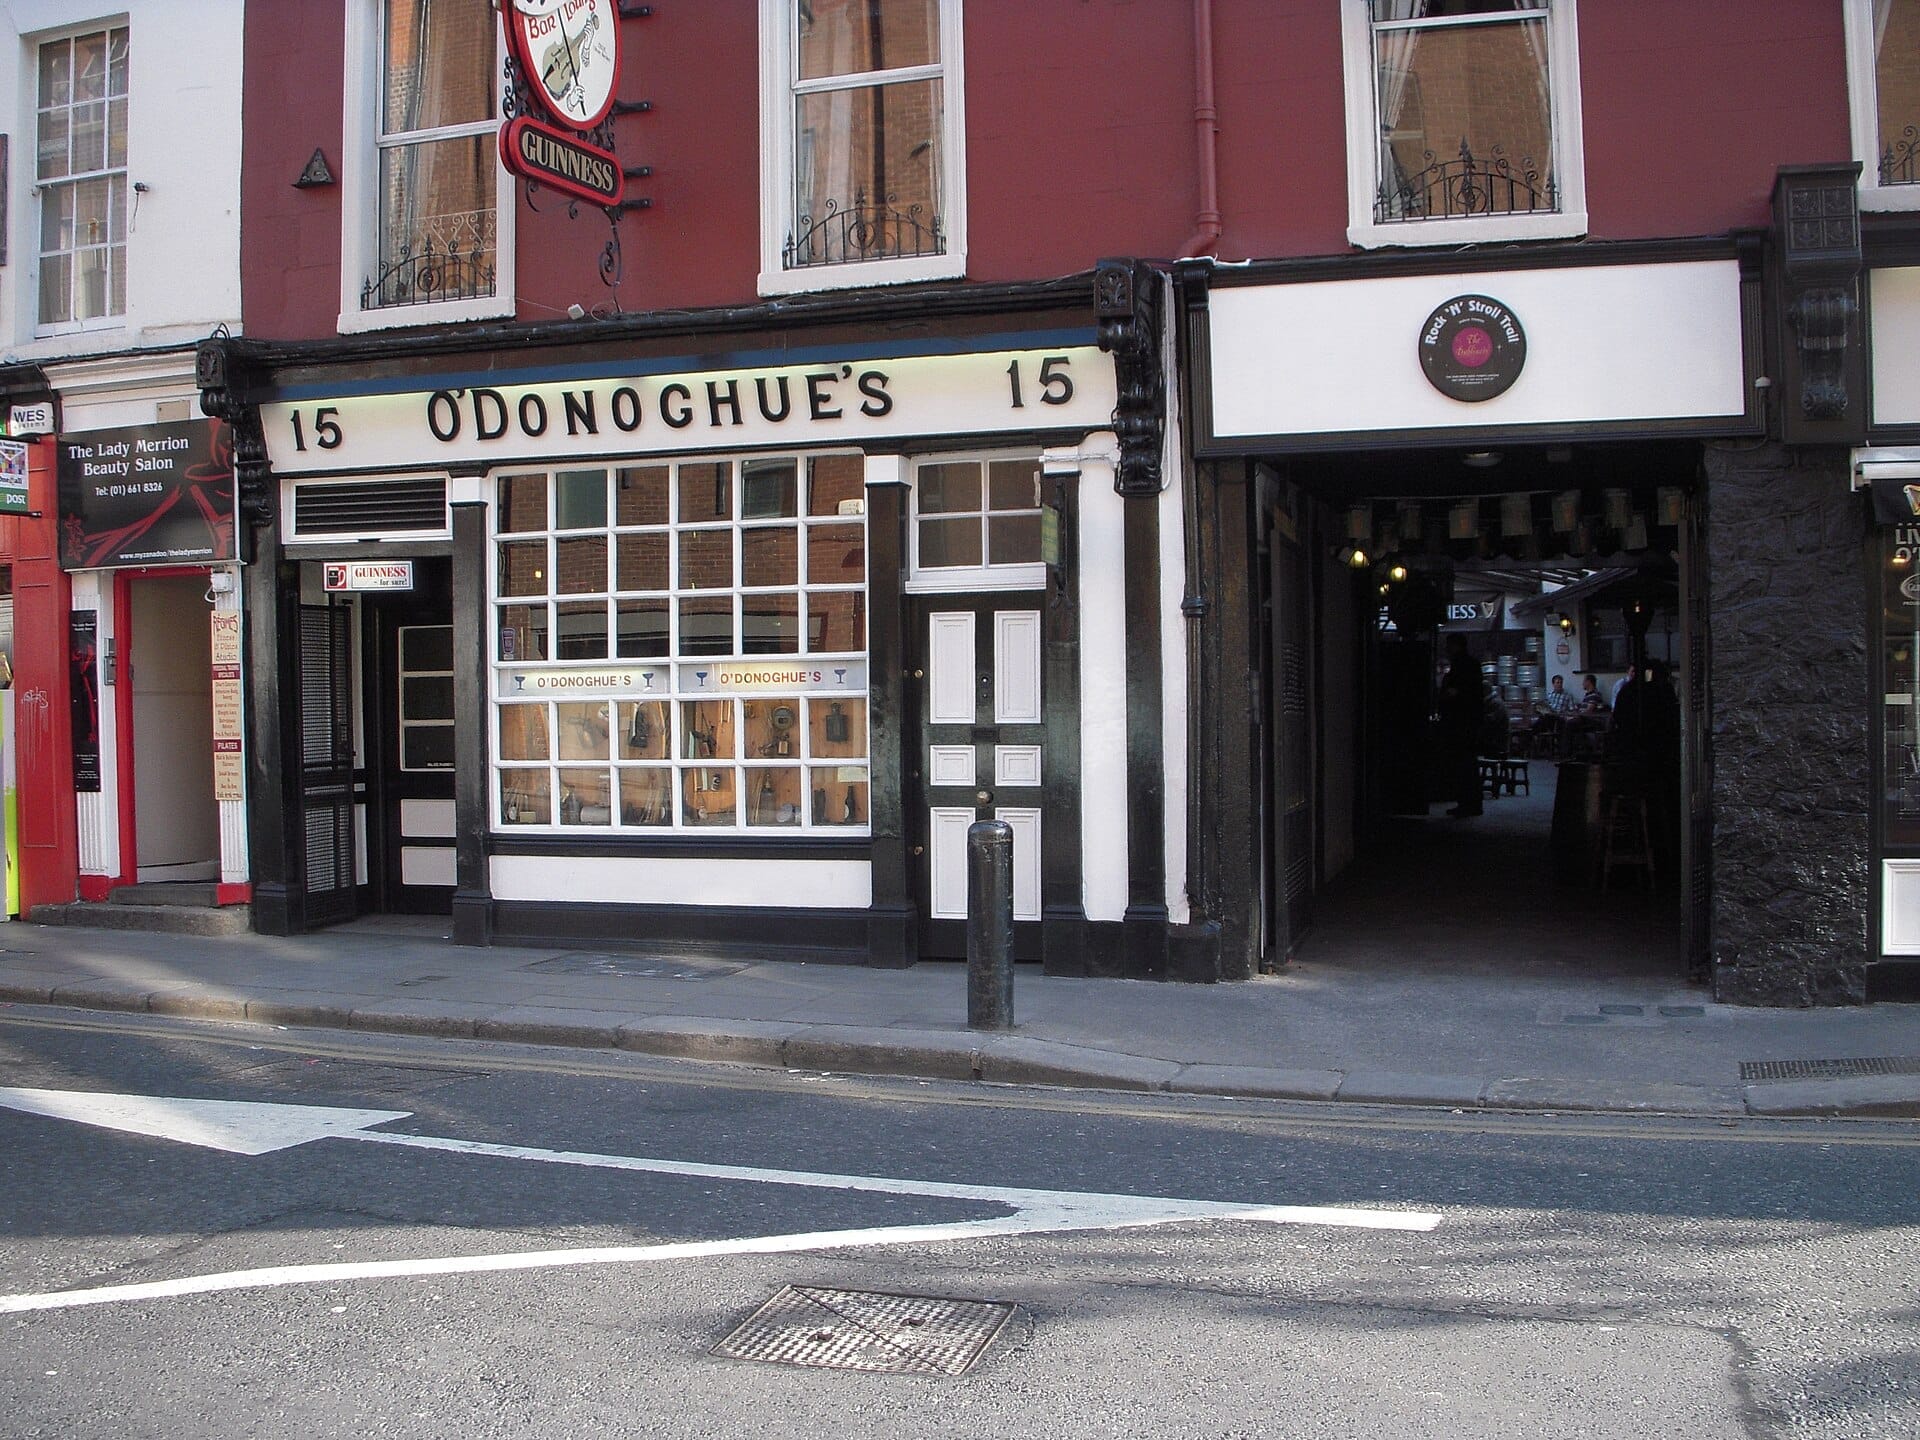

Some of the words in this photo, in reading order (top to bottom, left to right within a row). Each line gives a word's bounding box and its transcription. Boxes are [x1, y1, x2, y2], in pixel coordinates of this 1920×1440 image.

[528, 15, 556, 39] Bar
[522, 131, 613, 192] GUINNESS
[1425, 315, 1448, 345] Rock
[1468, 300, 1502, 319] Stroll
[1500, 315, 1521, 343] Trail
[1006, 356, 1074, 408] 15
[427, 364, 894, 442] O'DONOGHUE'S
[14, 409, 45, 422] WES
[290, 406, 343, 451] 15
[68, 445, 94, 459] The
[98, 441, 130, 458] Lady
[135, 436, 189, 454] Merrion
[84, 460, 130, 476] Beauty
[135, 456, 174, 472] Salon
[6, 493, 26, 504] post
[95, 486, 109, 496] Tel:
[110, 484, 126, 497] (01)
[127, 483, 141, 494] 661
[143, 481, 163, 492] 8326
[355, 566, 407, 578] GUINNESS
[1448, 604, 1477, 619] ESS
[537, 674, 632, 688] O'DONOGHUE'S
[720, 671, 822, 684] O'DONOGHUE'S
